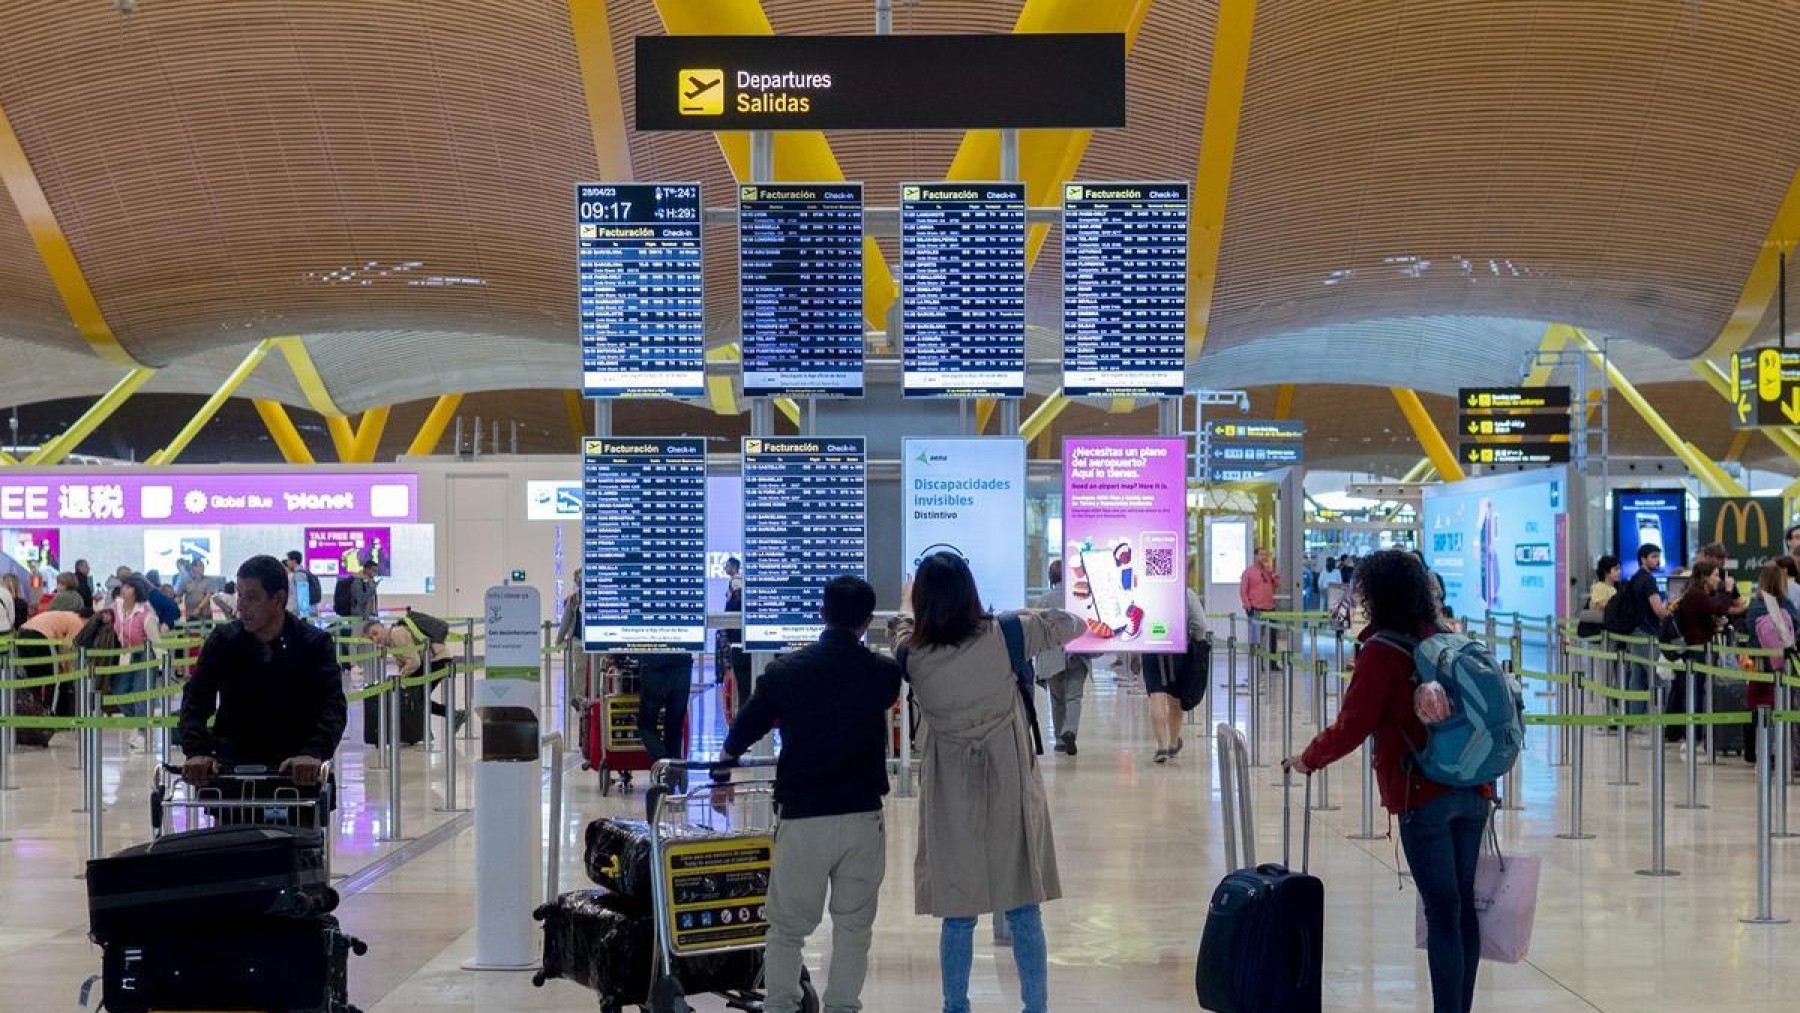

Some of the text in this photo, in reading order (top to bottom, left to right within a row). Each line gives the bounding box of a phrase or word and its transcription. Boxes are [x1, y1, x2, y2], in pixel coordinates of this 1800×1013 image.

[736, 71, 832, 91] Departures
[736, 93, 810, 113] Salidas
[581, 188, 616, 197] 28/04/23
[760, 189, 854, 199] Facturación Check-in
[922, 189, 1017, 199] Facturación Check-in
[1085, 189, 1180, 199] Facturación Check-in
[581, 202, 632, 219] 09:17
[599, 227, 693, 237] Facturación Check-in
[604, 444, 697, 453] Facturación Check-in
[764, 443, 856, 452] Facturación Check-in
[1072, 447, 1167, 458] ¿Necesitas un plano
[1072, 458, 1147, 469] del aeropuerto?
[1072, 469, 1140, 479] Aquí lo tienes.
[914, 478, 1011, 491] Discapacidades
[211, 495, 272, 508] Global Blue
[914, 494, 974, 506] invisibles
[914, 511, 957, 519] Distintivo
